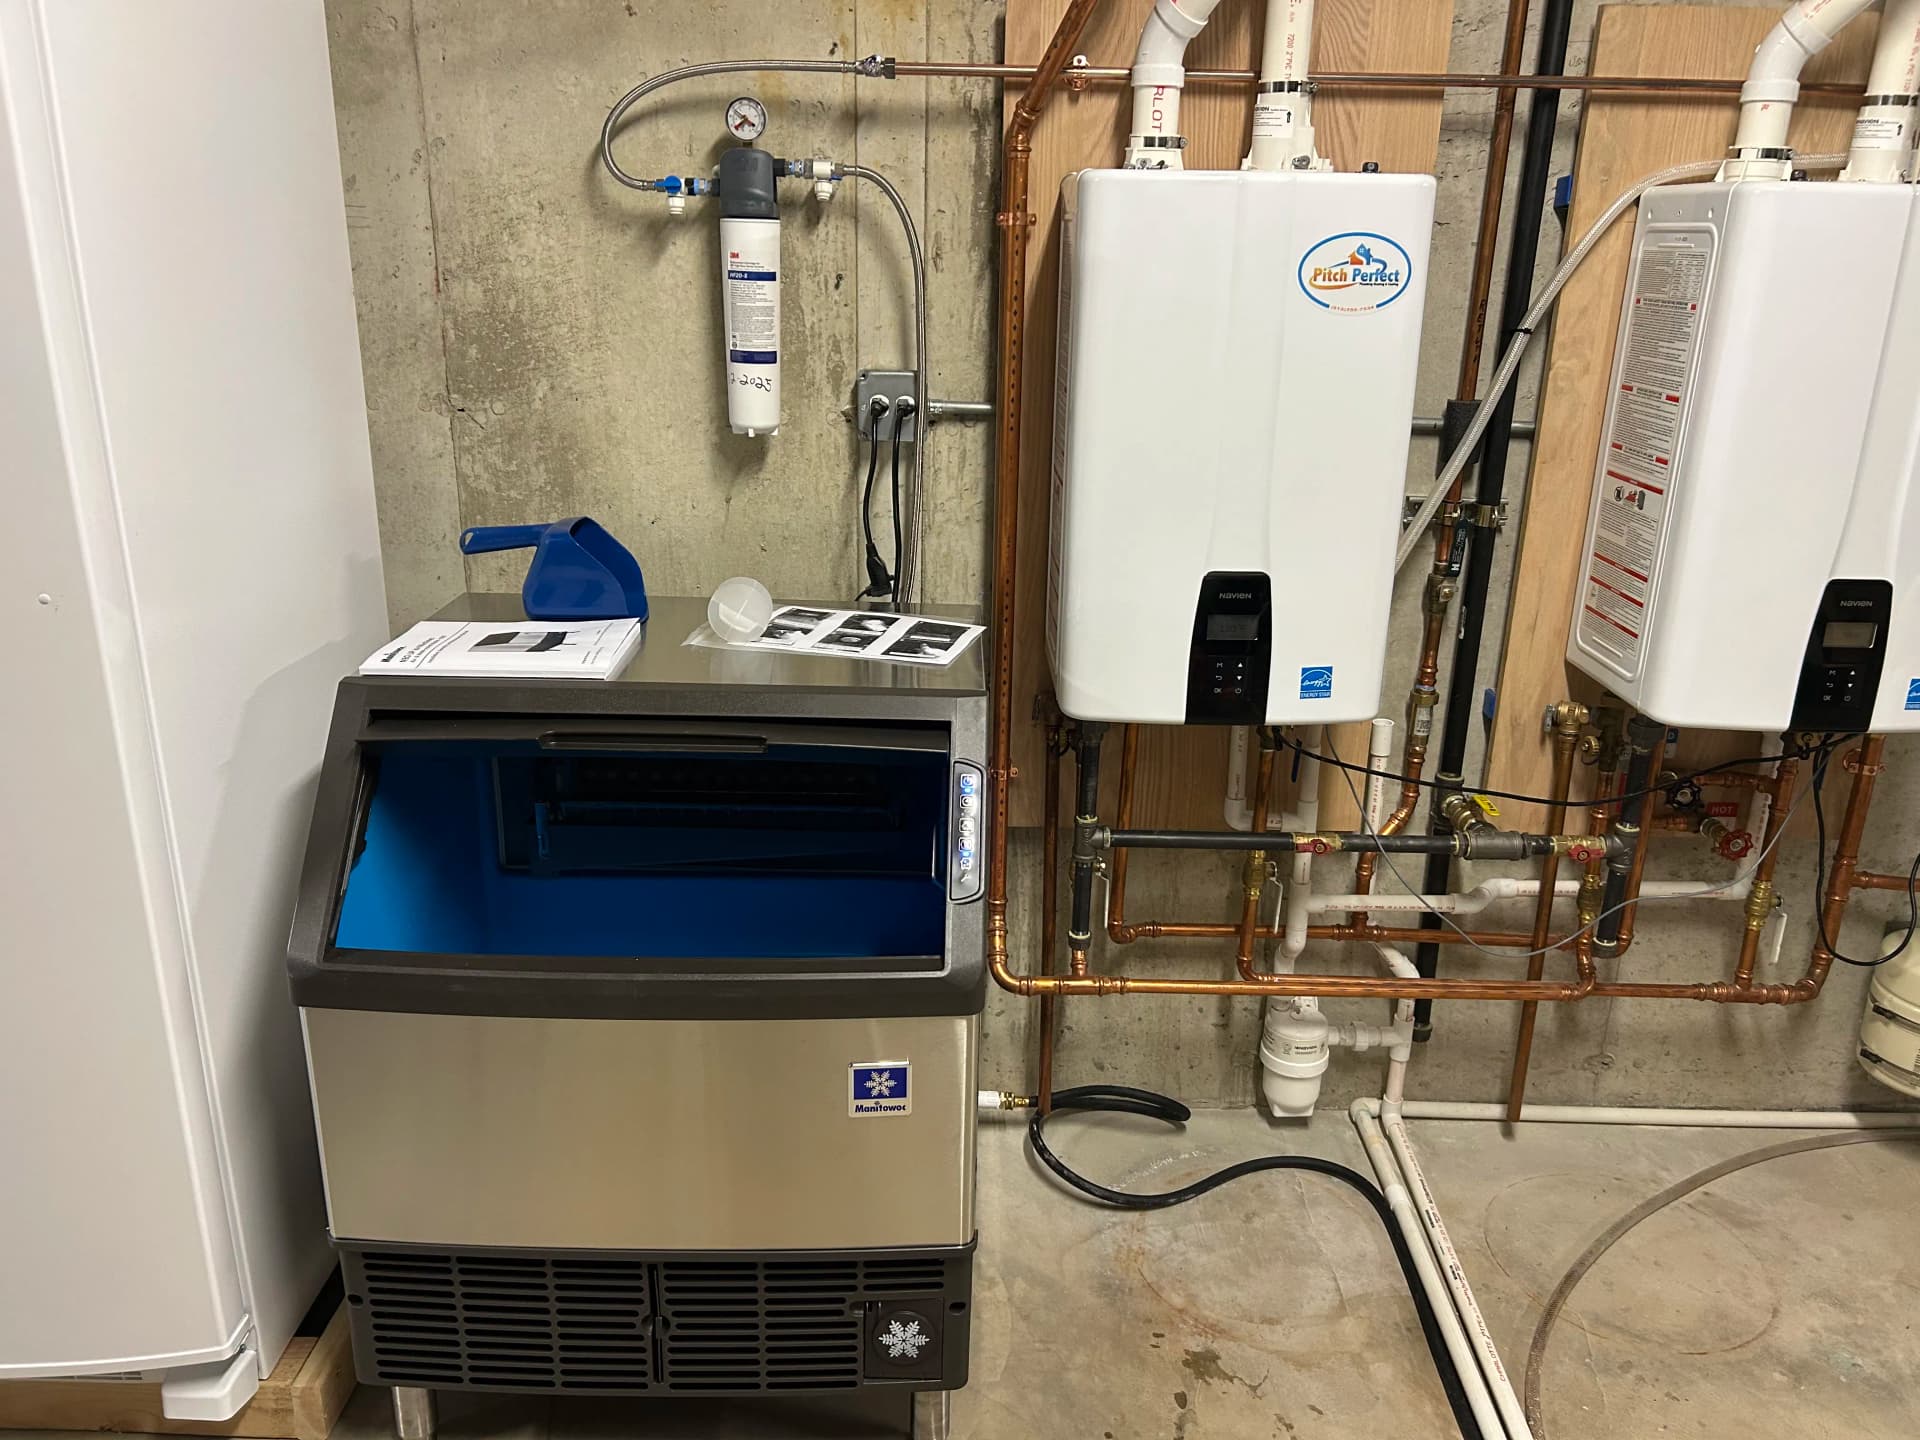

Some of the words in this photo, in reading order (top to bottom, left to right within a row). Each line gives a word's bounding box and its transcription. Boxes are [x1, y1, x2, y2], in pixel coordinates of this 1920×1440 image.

[1313, 267, 1348, 282] Pitch
[1352, 268, 1400, 282] Perfect
[1711, 806, 1734, 816] HOT
[855, 1103, 906, 1113] Manitowoc
